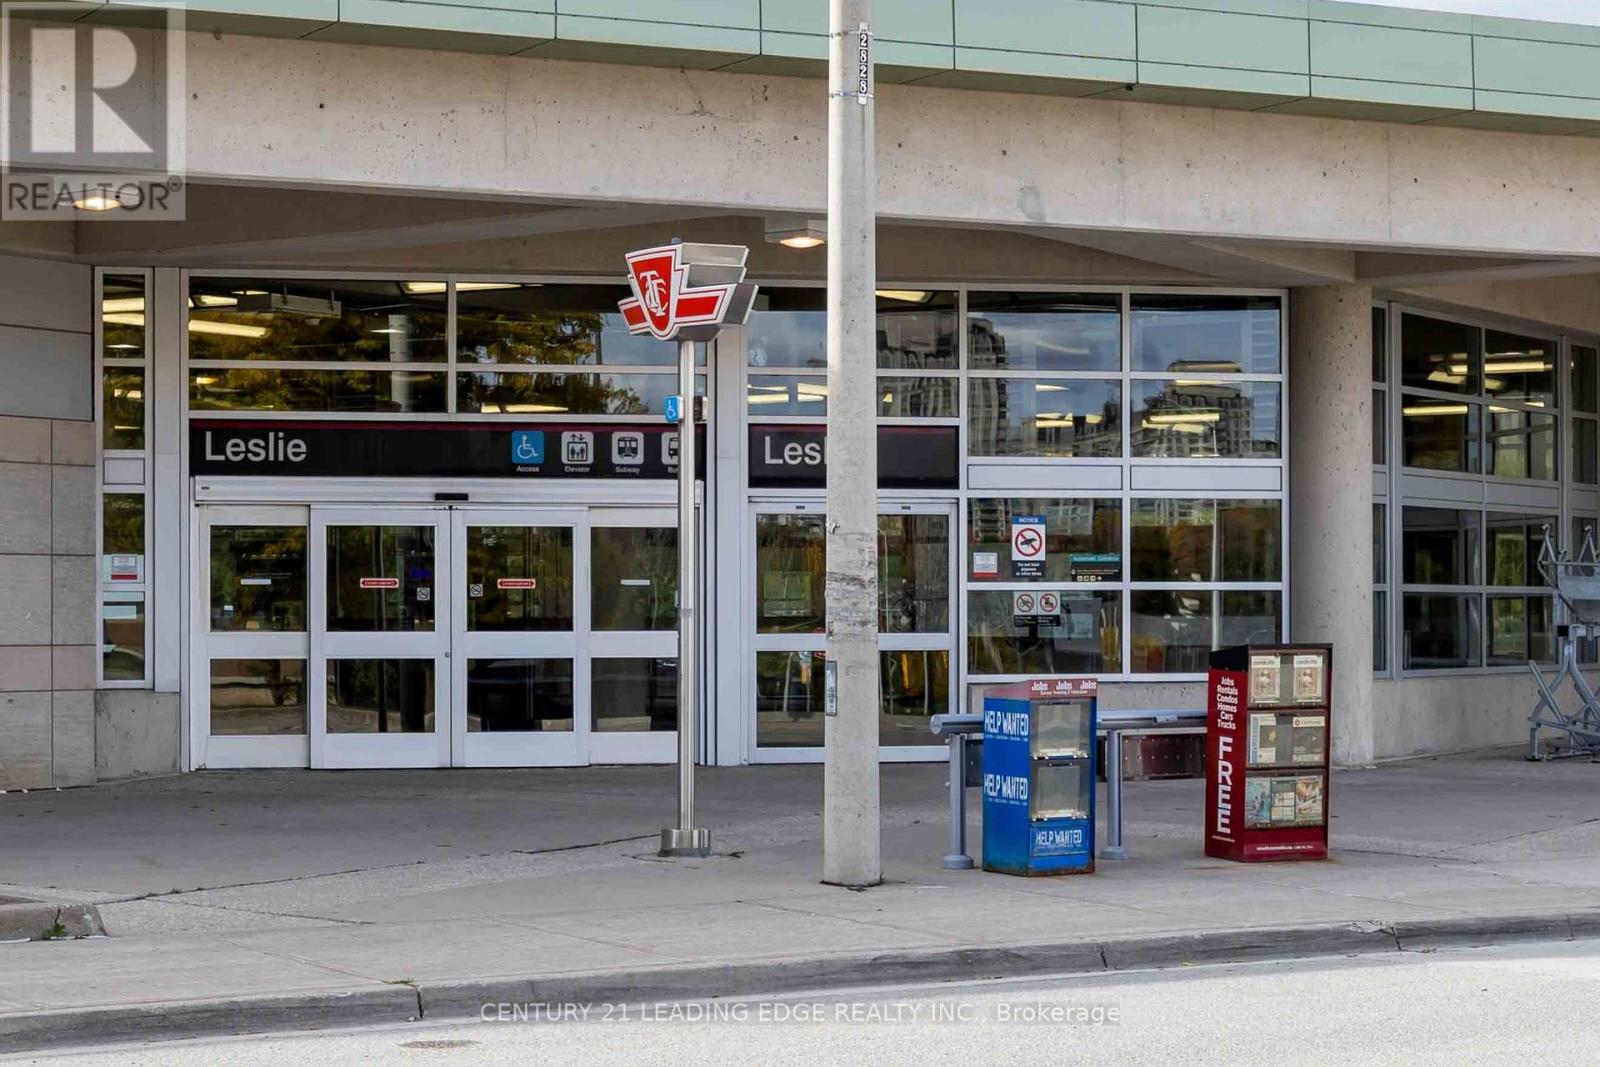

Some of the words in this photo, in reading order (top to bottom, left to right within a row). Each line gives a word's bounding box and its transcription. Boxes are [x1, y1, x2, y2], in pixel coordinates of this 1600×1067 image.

[860, 33, 868, 94] 2828
[205, 431, 307, 462] Leslie
[516, 465, 540, 473] Access
[564, 465, 590, 473] Elevator
[615, 466, 640, 474] Subway
[1031, 681, 1048, 692] Jobs
[1055, 680, 1073, 691] Jobs
[1080, 680, 1097, 690] Jobs
[1221, 677, 1235, 686] Jobs
[1217, 685, 1238, 695] Rentals
[1216, 694, 1238, 704] Condos
[1217, 703, 1237, 713] Homes
[1220, 712, 1234, 721] Cars
[984, 710, 1001, 734] HELP
[1002, 711, 1029, 736] WANTED
[1217, 719, 1236, 730] Trucks
[984, 773, 1000, 797] HELP
[1001, 775, 1028, 800] WANTED
[1217, 735, 1234, 834] FREE
[1036, 831, 1054, 846] HELP
[1055, 829, 1082, 845] WANTED
